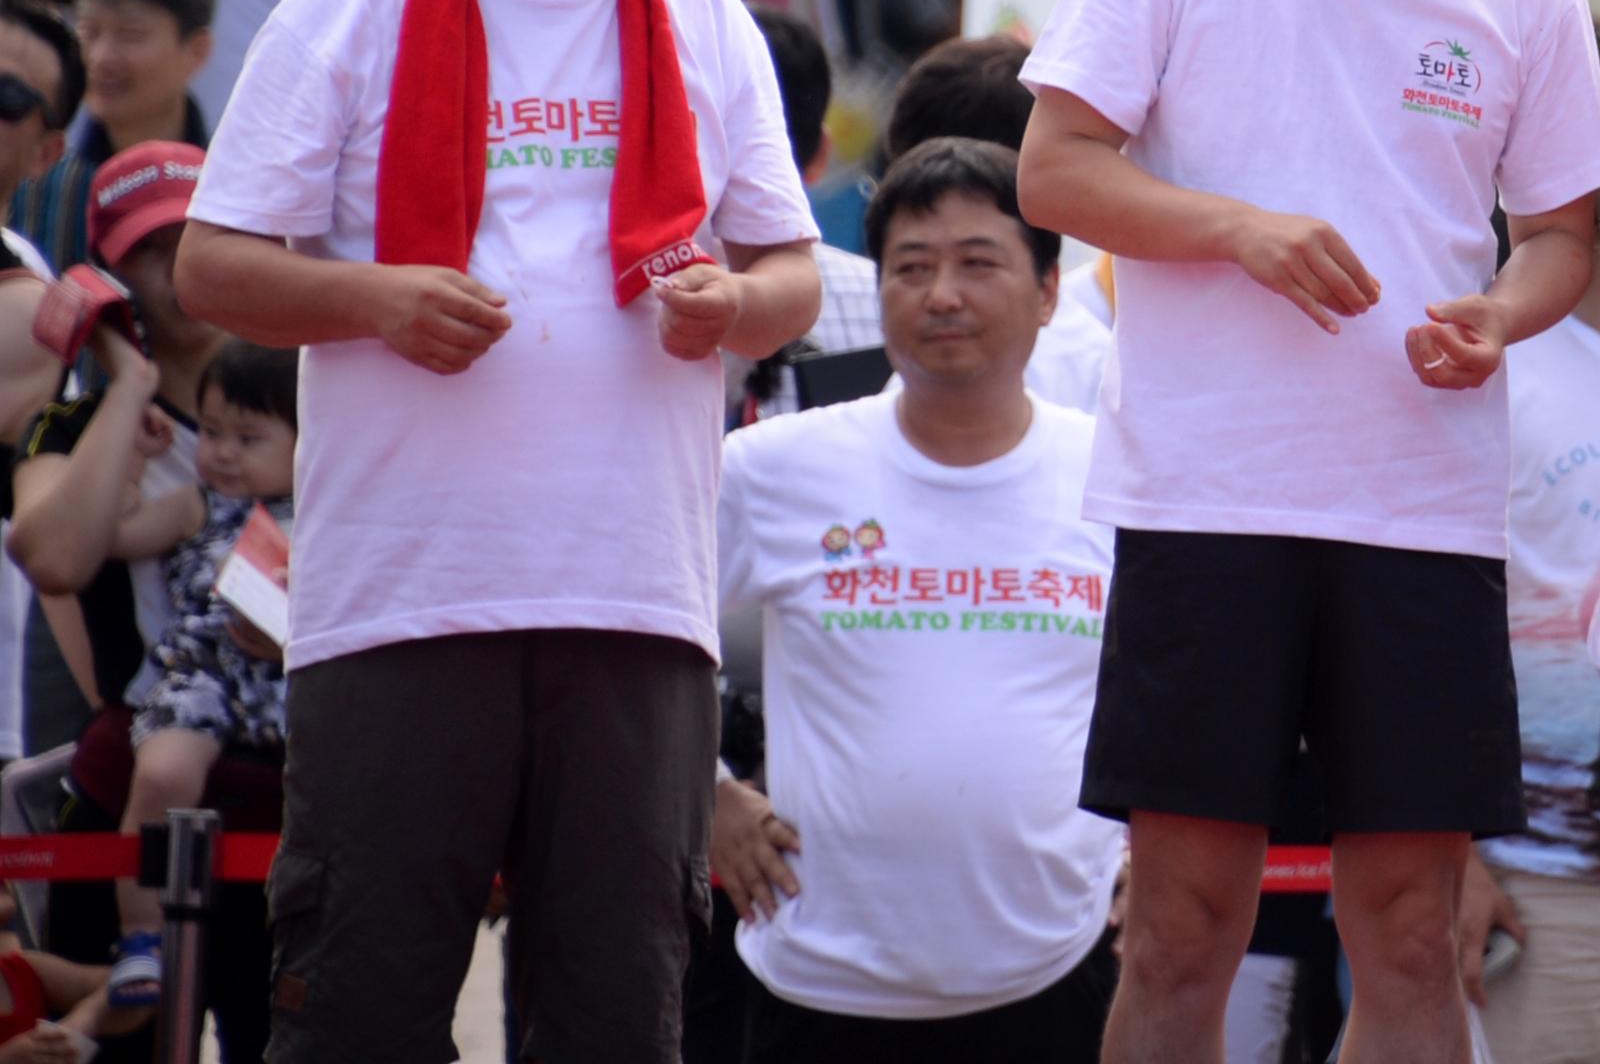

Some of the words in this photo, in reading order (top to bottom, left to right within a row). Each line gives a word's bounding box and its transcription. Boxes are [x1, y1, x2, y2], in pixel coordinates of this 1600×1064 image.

[1415, 52, 1472, 88] 토마토
[821, 564, 1104, 613] 화천토마토축제
[820, 609, 951, 633] TOMATO
[958, 610, 1102, 639] FESTIVAL
